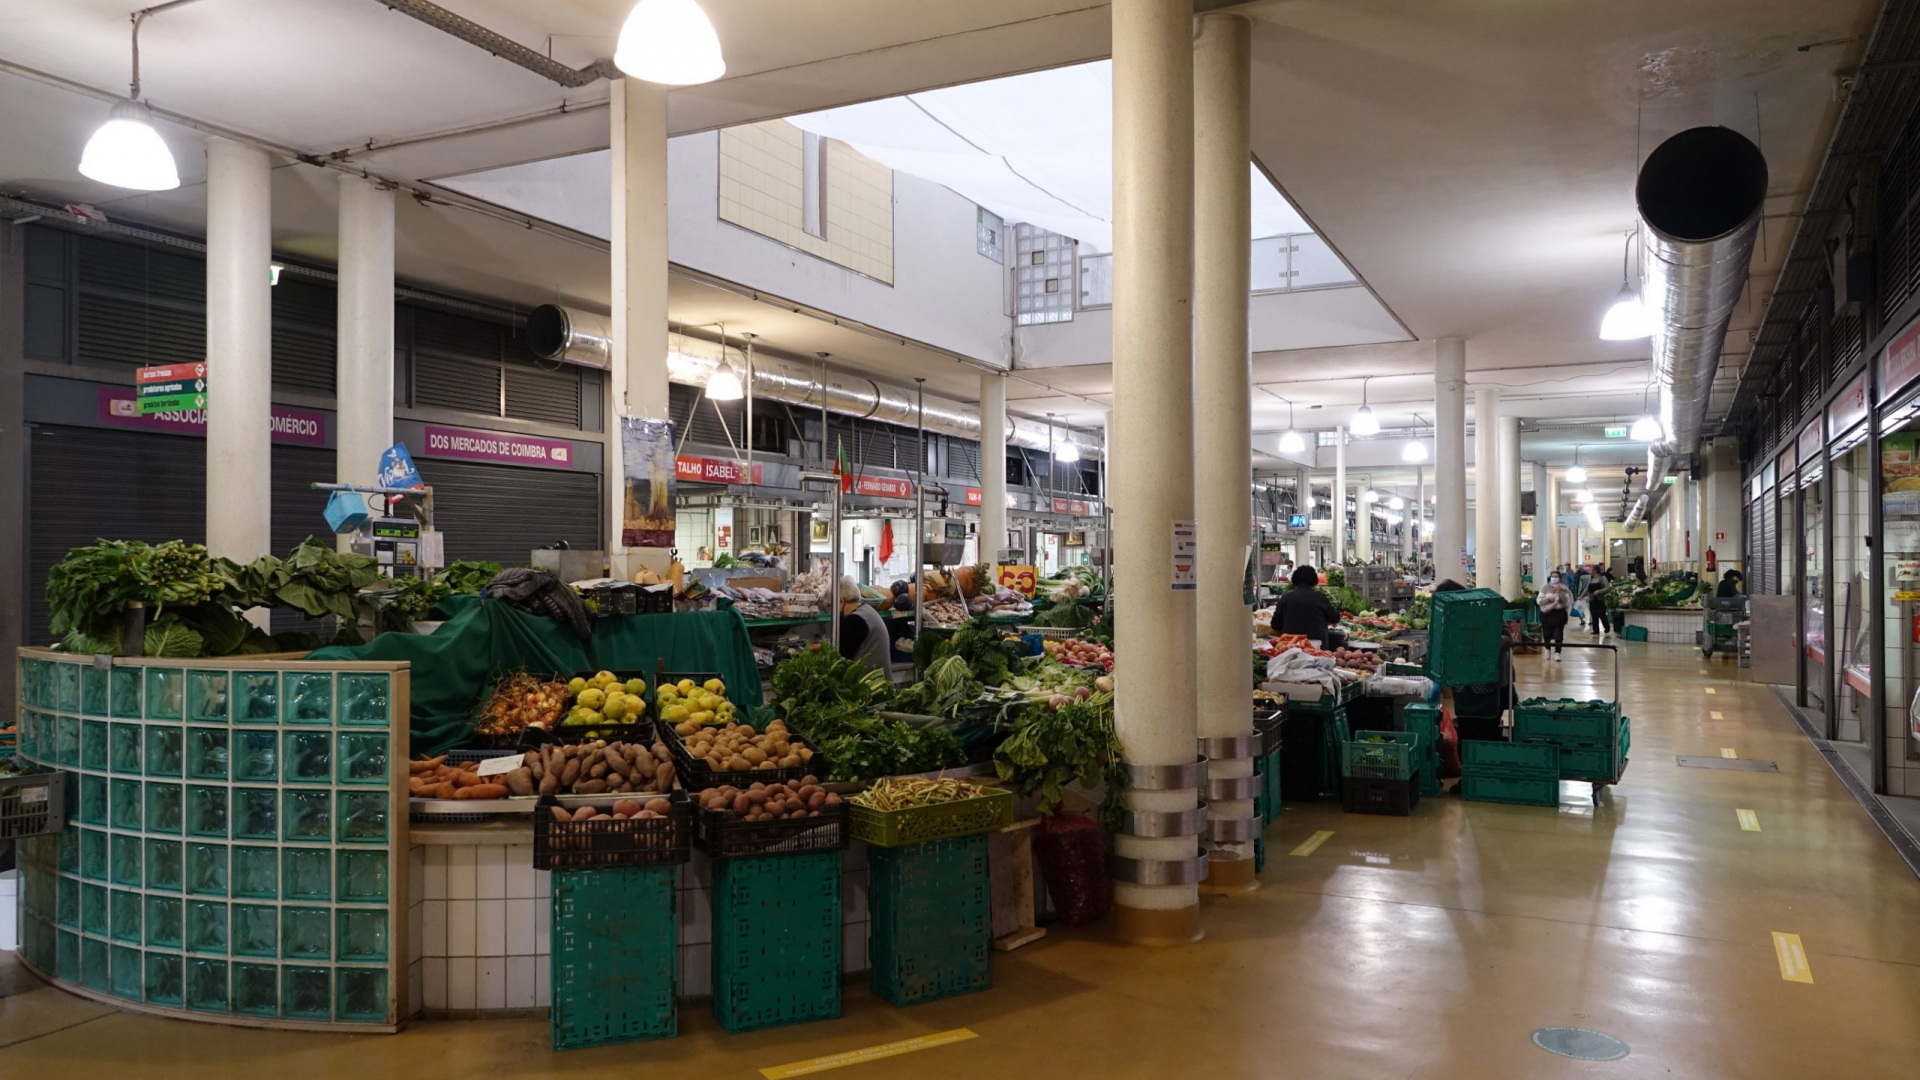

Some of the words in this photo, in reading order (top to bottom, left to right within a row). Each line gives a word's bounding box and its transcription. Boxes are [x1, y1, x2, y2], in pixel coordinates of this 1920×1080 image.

[430, 434, 449, 449] DOS
[451, 436, 498, 454] MERCADOS
[499, 441, 509, 455] DE
[511, 443, 547, 459] COIMBRA
[677, 461, 702, 475] TALHO
[705, 464, 735, 478] ISABEL
